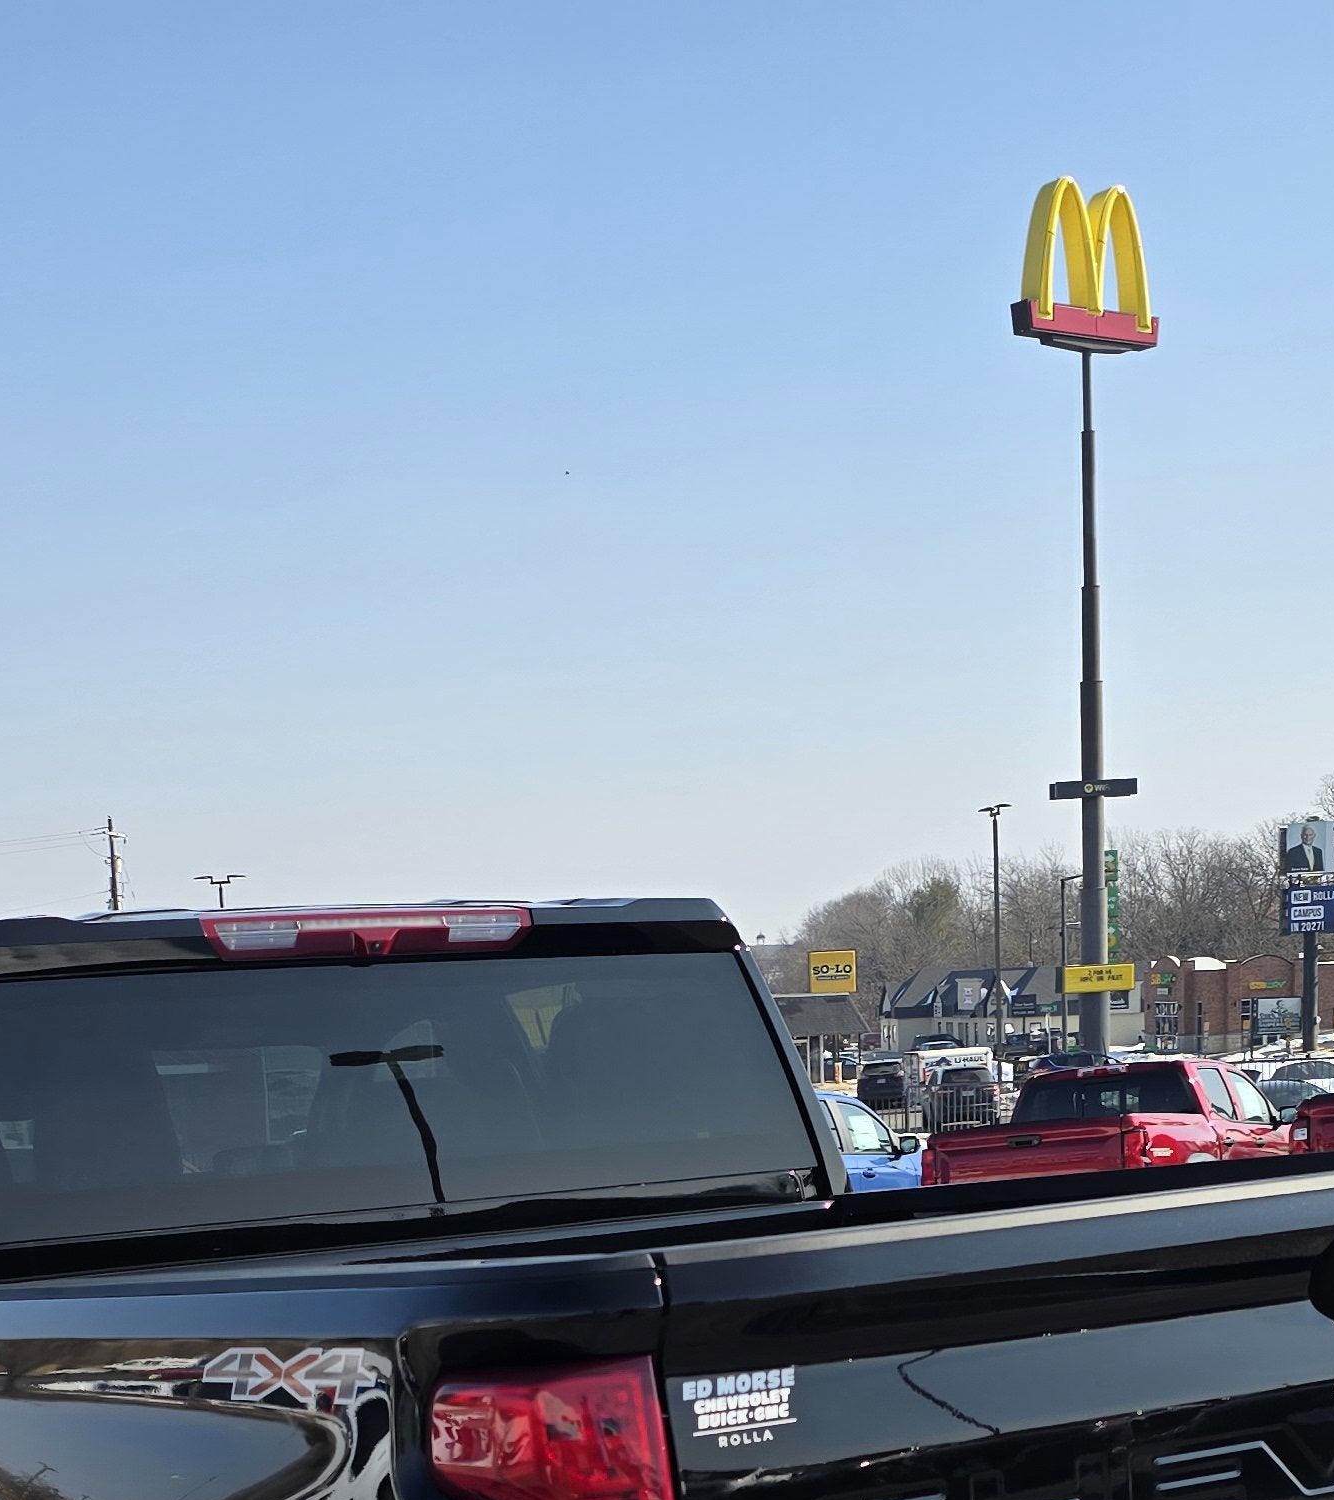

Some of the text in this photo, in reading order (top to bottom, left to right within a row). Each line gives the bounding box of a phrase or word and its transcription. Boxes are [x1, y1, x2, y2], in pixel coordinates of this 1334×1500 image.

[1293, 892, 1310, 901] NEW
[1293, 907, 1322, 918] CAMPUS
[1290, 923, 1300, 932] IN
[812, 964, 852, 975] SO-LO
[202, 1346, 378, 1405] 4X4
[682, 1366, 795, 1401] ED MORSE
[694, 1387, 791, 1415] CHEVROLET
[718, 1429, 774, 1448] ROLLA
